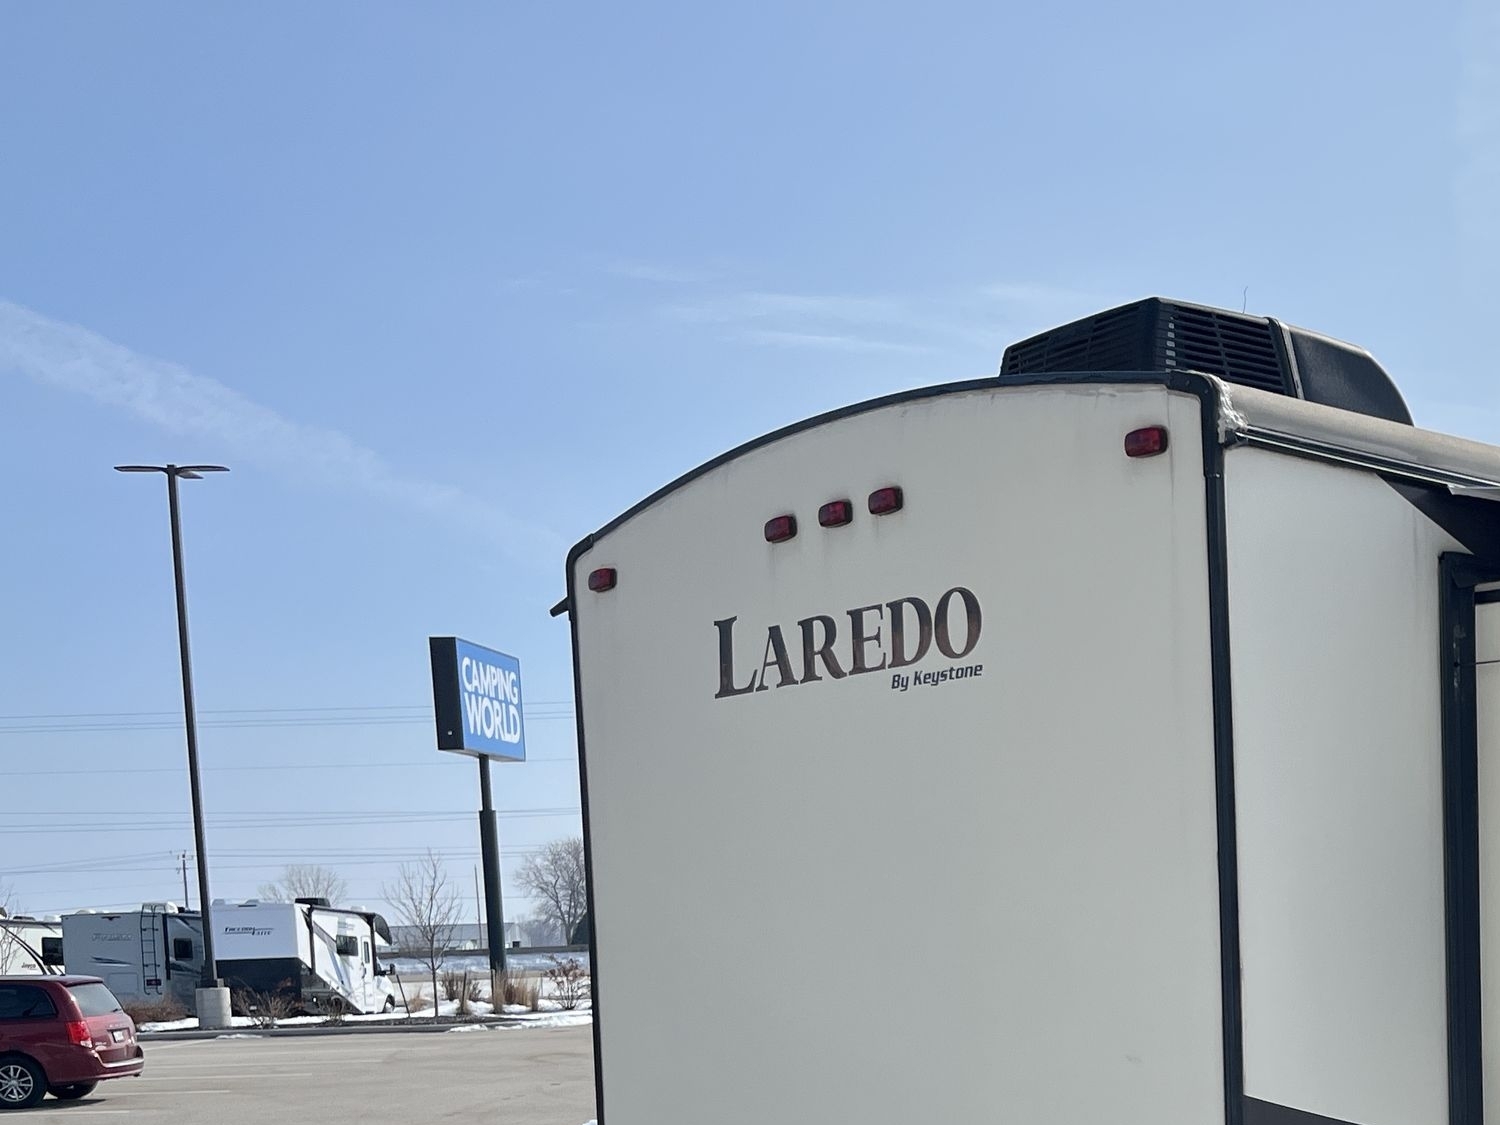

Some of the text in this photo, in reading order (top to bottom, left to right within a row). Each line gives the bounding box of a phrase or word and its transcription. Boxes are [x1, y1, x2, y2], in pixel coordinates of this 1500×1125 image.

[714, 586, 982, 699] LAREDO
[462, 657, 518, 705] CAMPING
[891, 664, 983, 692] By Keystone
[464, 692, 520, 744] WORLD
